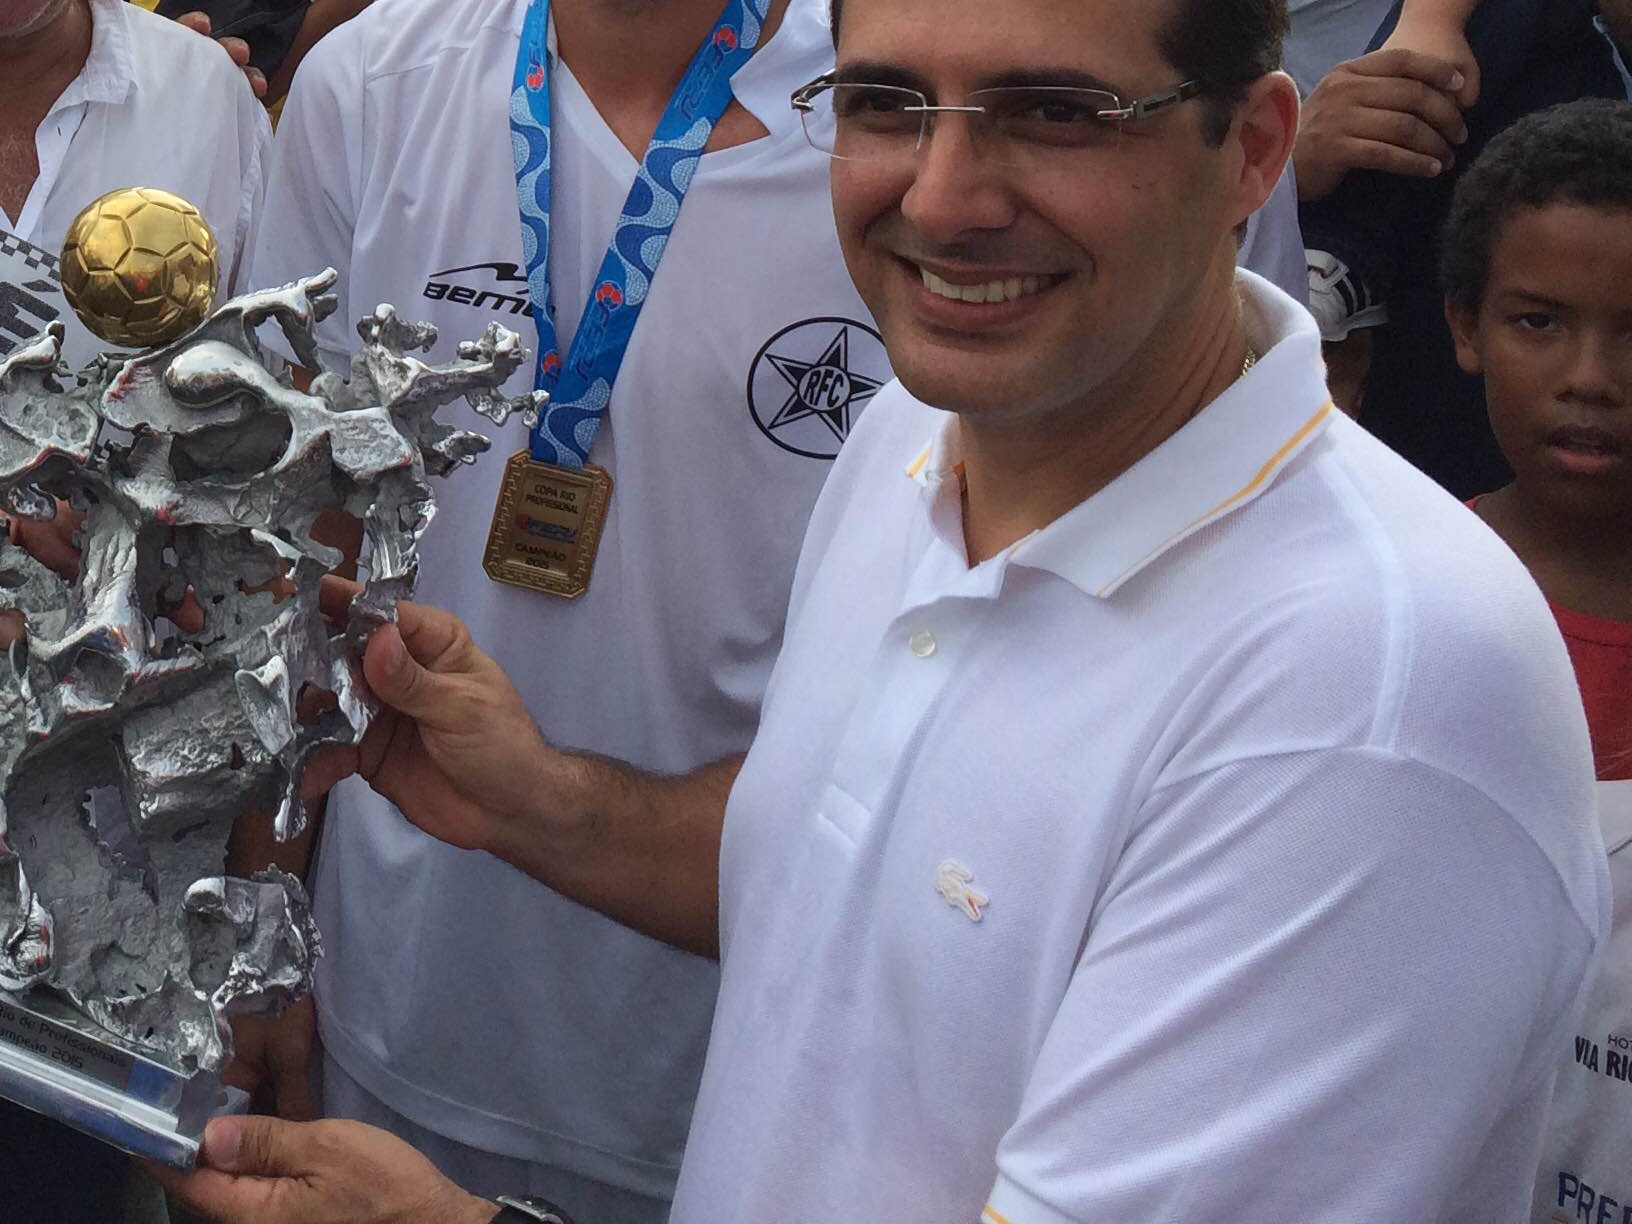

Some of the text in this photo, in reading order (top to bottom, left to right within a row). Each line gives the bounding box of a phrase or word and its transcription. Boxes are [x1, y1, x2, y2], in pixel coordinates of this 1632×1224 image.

[803, 368, 845, 409] RFC
[19, 1016, 36, 1029] de
[1575, 1035, 1599, 1073] VIA
[1608, 1034, 1632, 1051] HO
[51, 1046, 84, 1069] 2015
